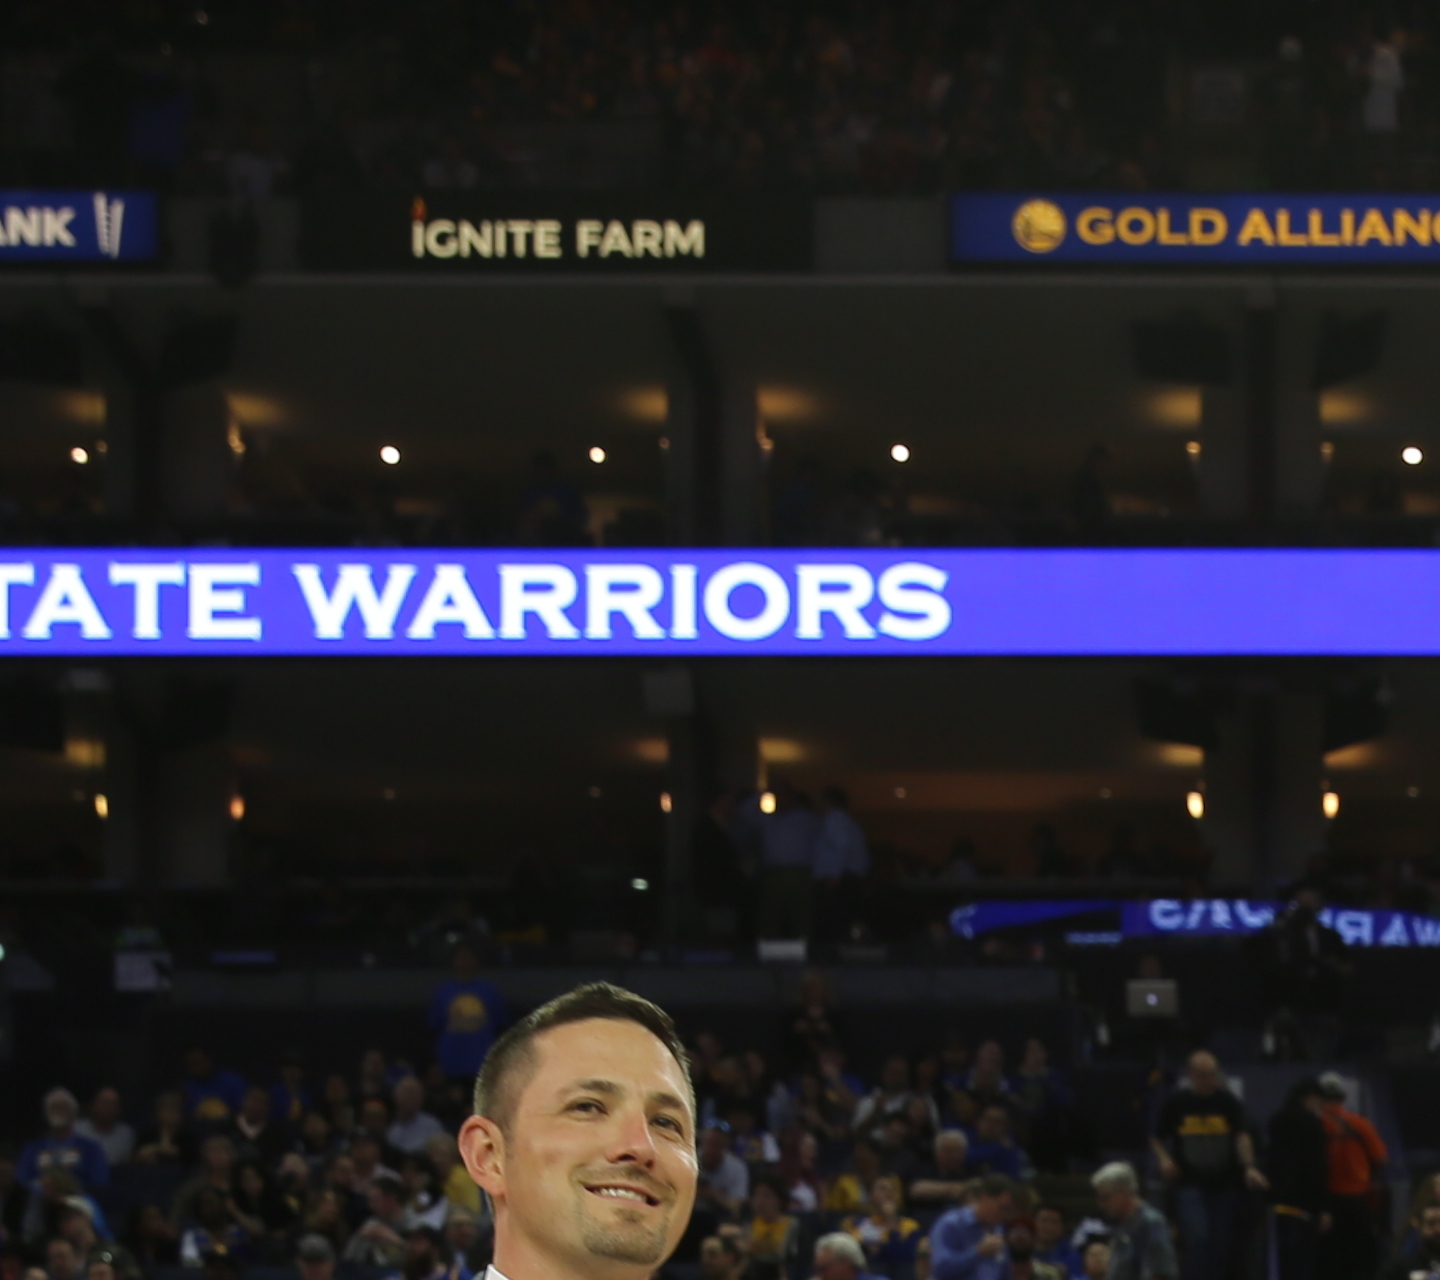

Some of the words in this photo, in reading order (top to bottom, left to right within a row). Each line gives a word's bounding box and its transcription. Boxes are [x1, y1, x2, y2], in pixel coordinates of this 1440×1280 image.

[412, 220, 562, 258] IGNITE
[576, 220, 705, 258] FARM
[1076, 207, 1228, 246] GOLD
[293, 562, 951, 639] WARRIORS
